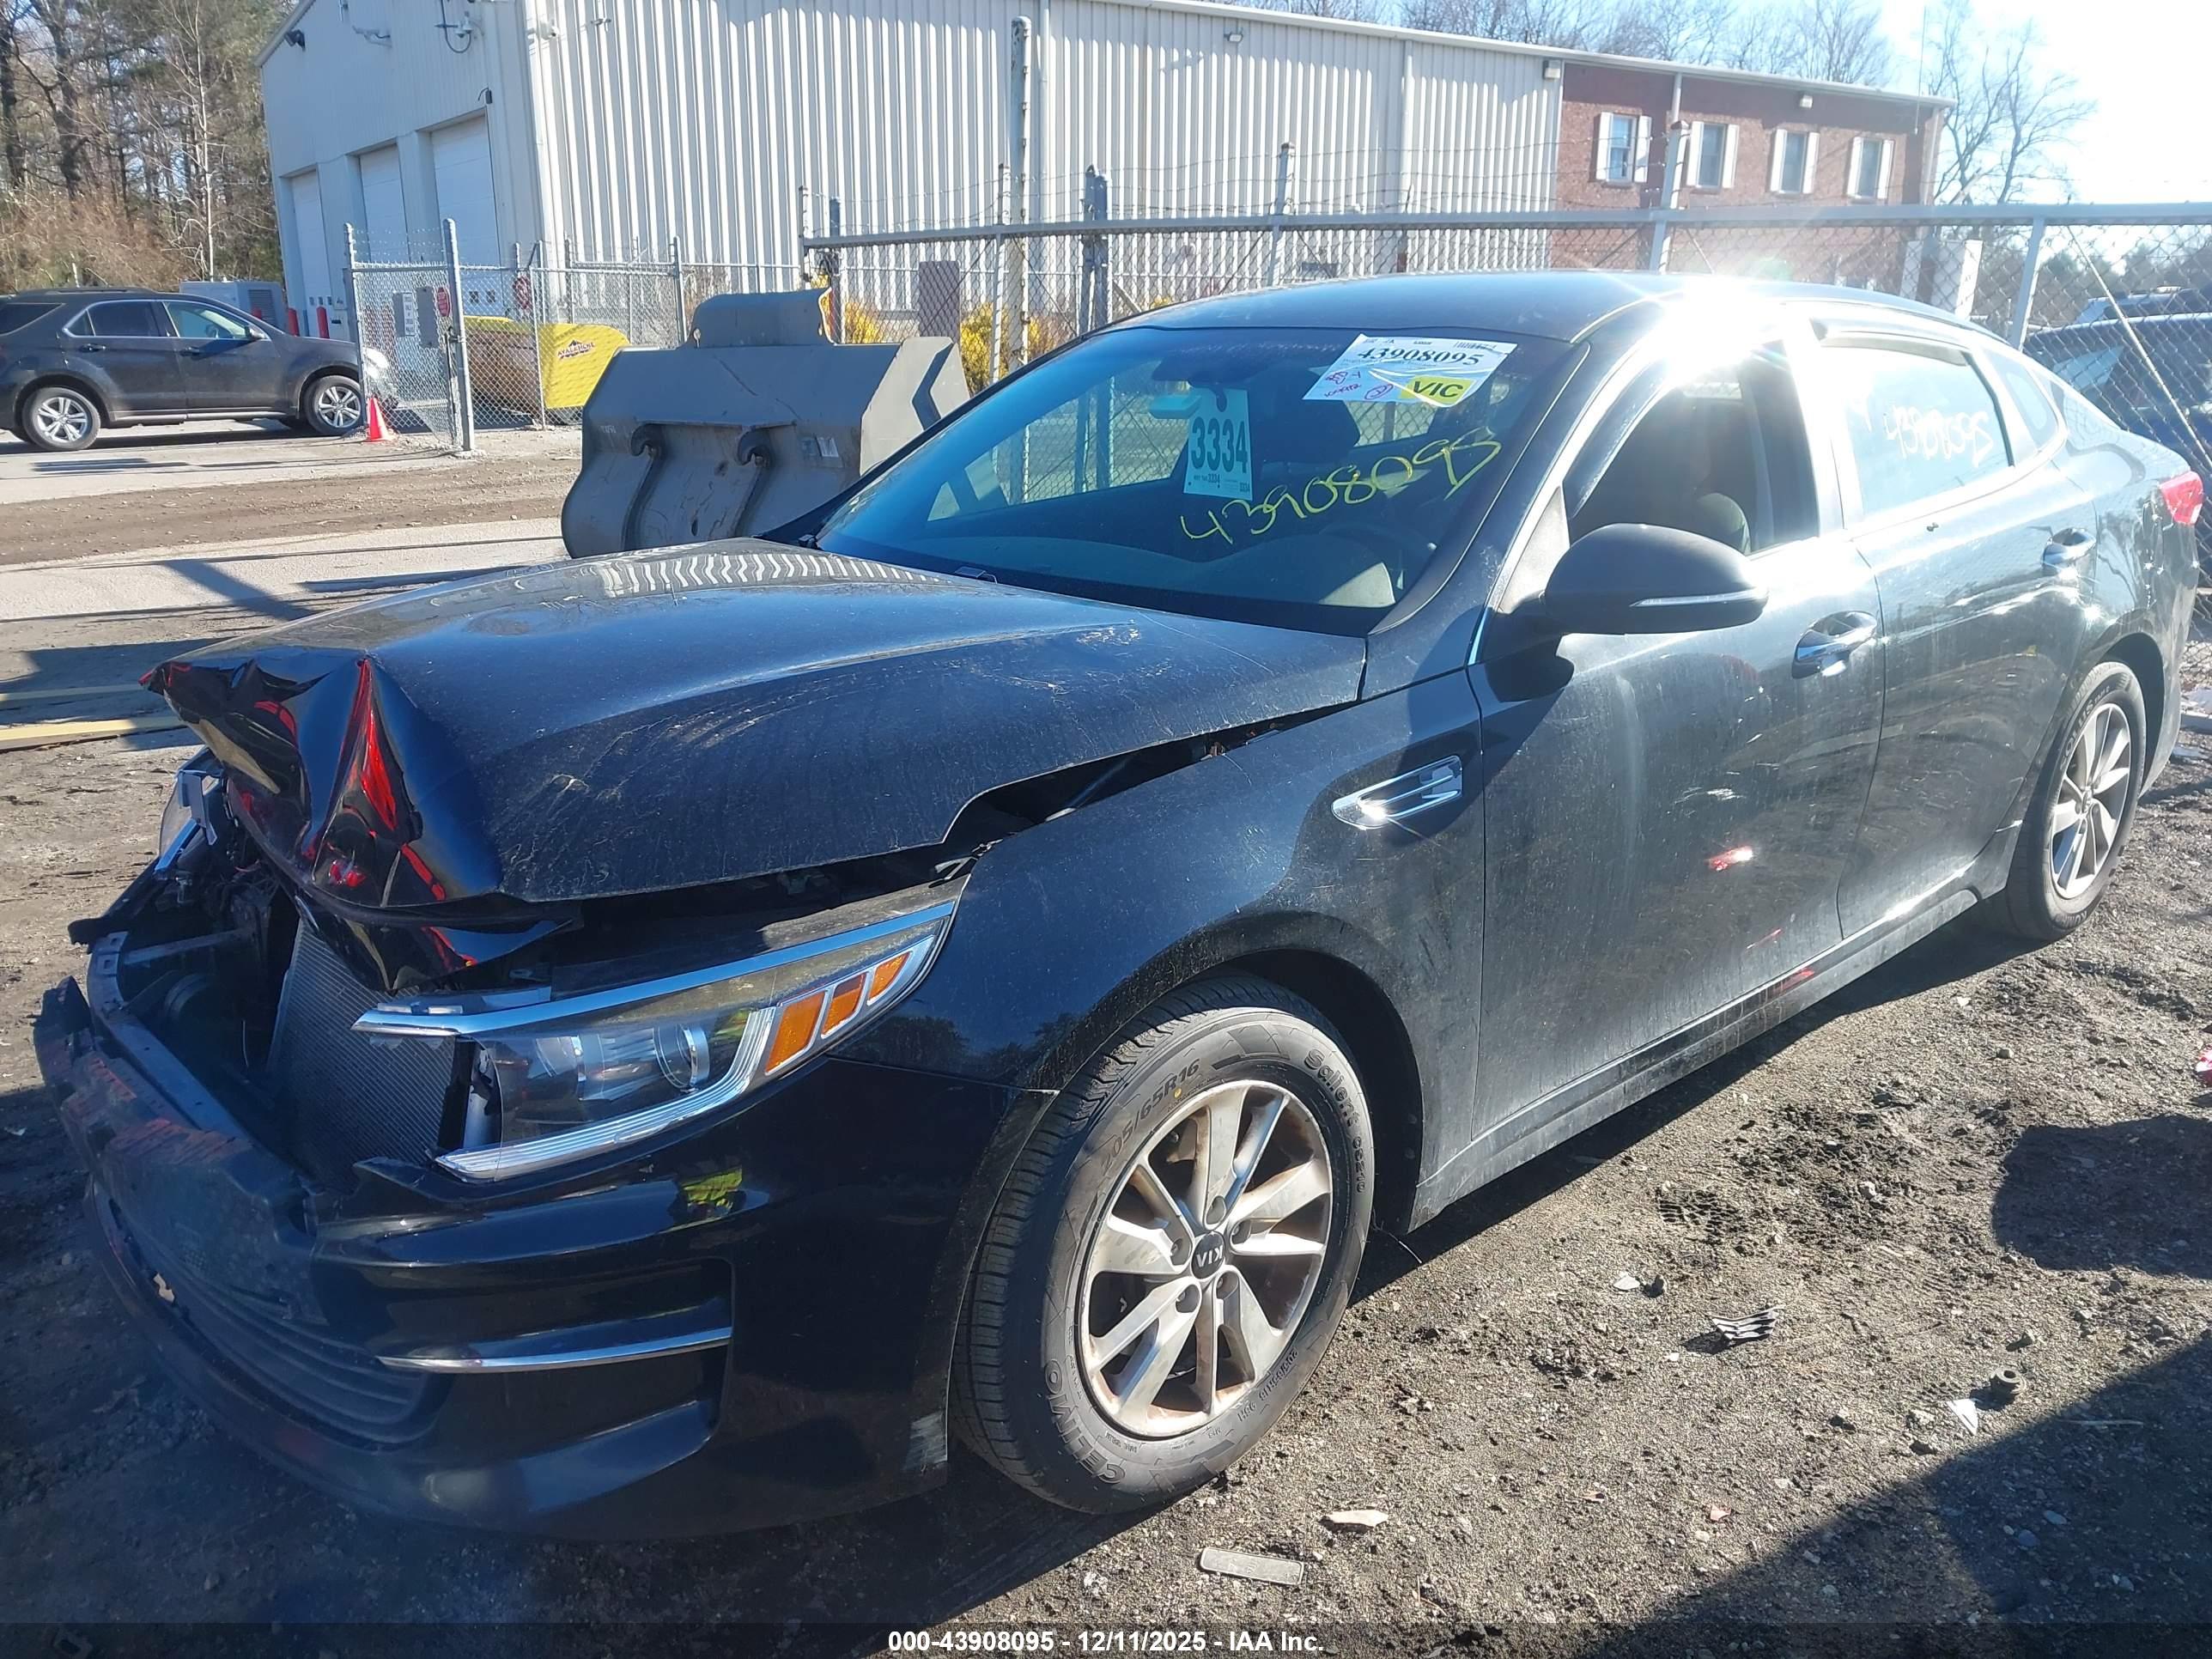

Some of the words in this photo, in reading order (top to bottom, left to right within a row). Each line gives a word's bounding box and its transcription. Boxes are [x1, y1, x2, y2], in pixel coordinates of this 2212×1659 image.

[1357, 346, 1486, 367] 43908095
[1413, 380, 1465, 398] VIC
[1191, 416, 1249, 474] 3334
[1179, 426, 1504, 545] 43908095
[1100, 1059, 1201, 1174] 205/65R16
[1304, 1048, 1360, 1127] Salient
[1196, 1244, 1224, 1267] KIA
[1044, 1360, 1126, 1485] CELIMO
